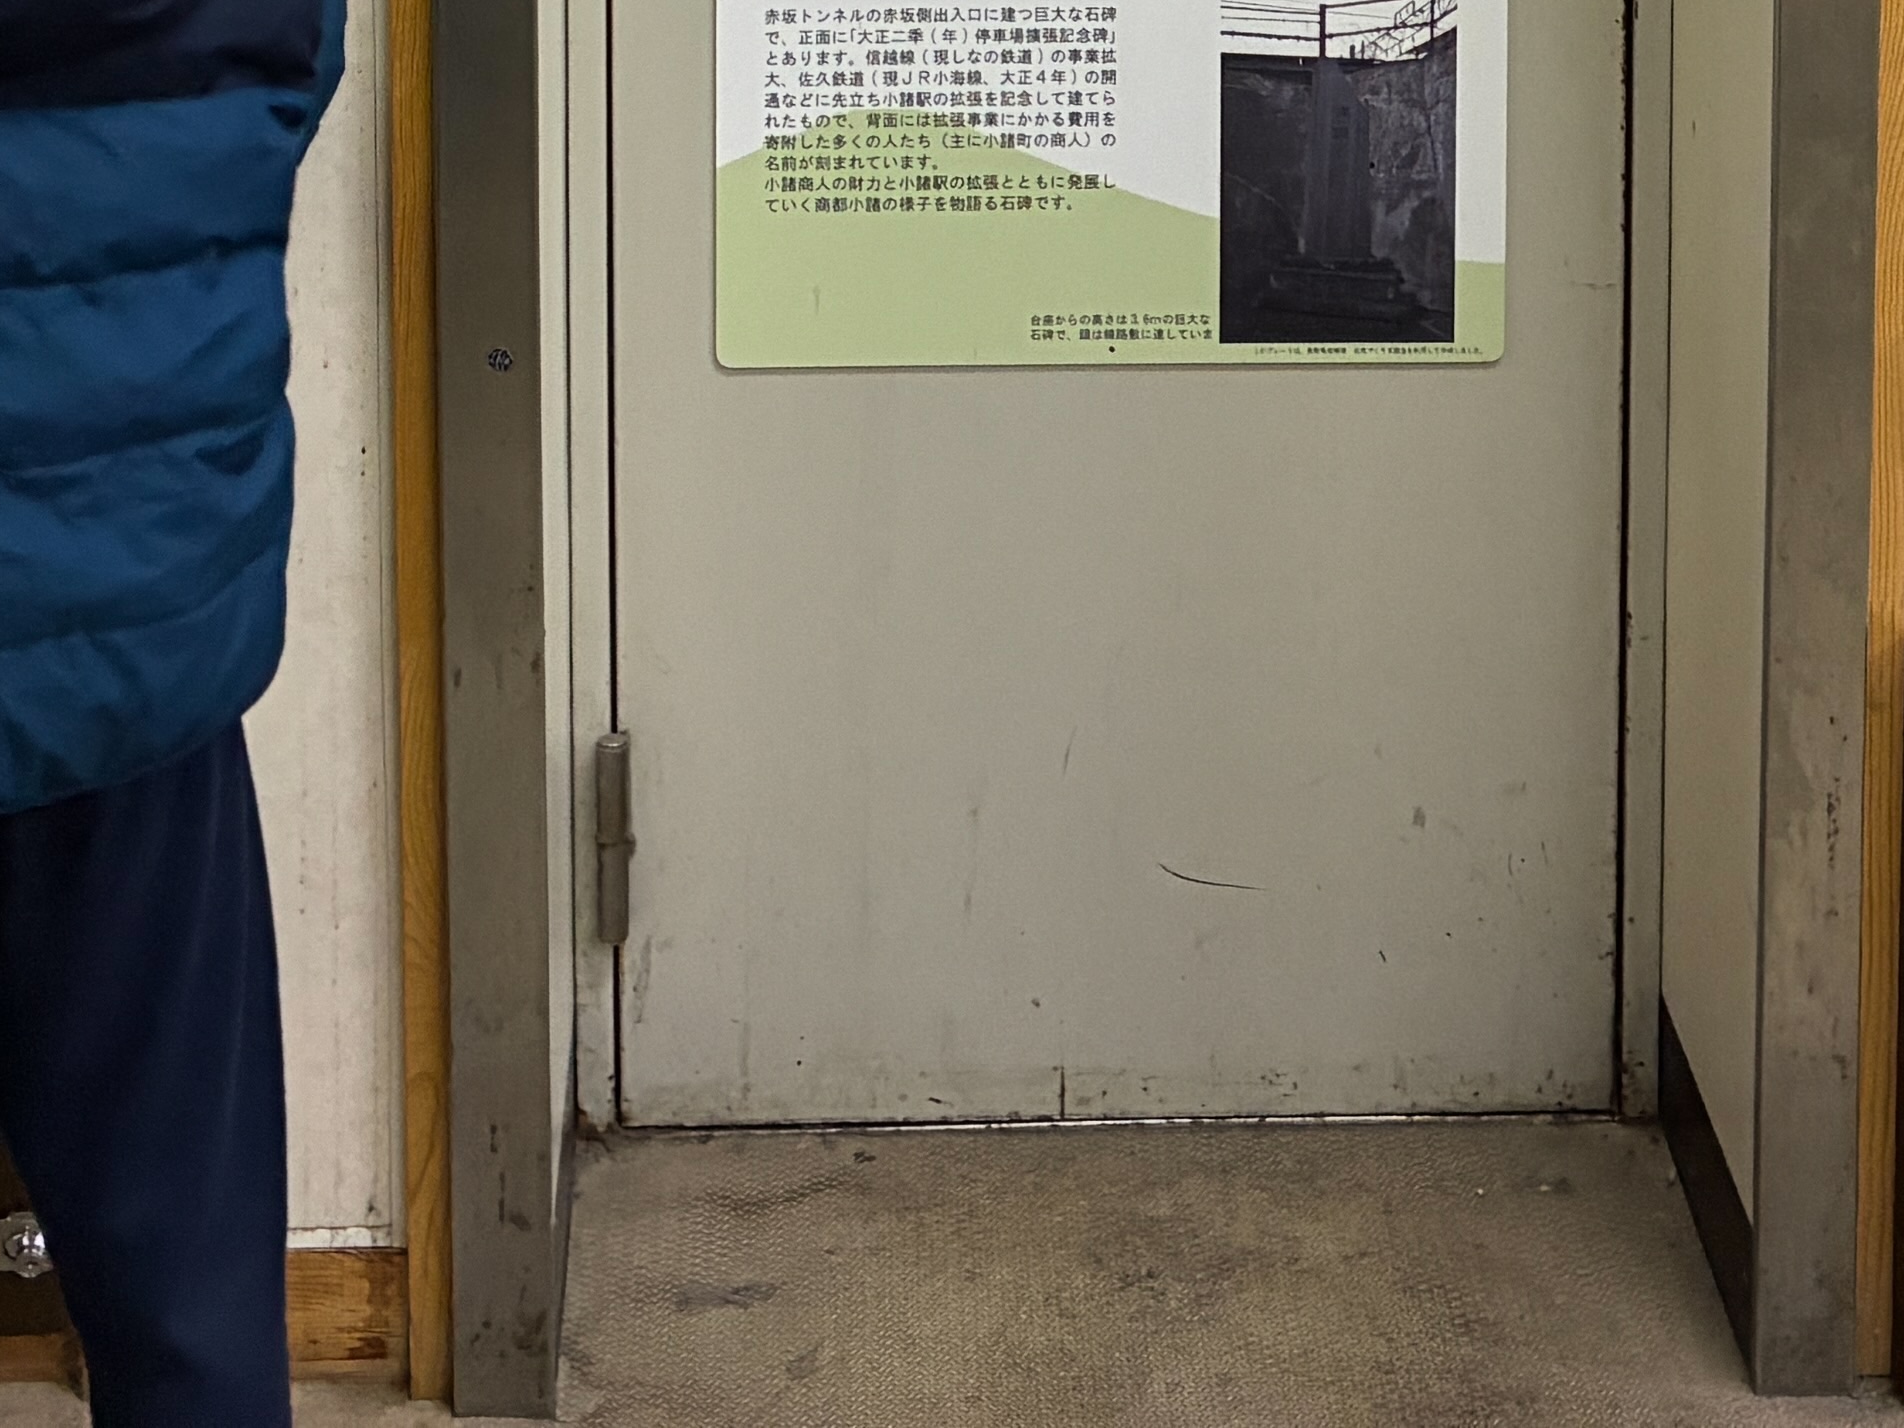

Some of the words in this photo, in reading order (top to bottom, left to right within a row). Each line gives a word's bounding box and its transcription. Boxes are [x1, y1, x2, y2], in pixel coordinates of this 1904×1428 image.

[765, 8, 1117, 24] 赤坂トンネルの赤坂側出入口に建つ巨大な石碑
[765, 92, 1115, 108] 通などに先立ち小諸駅の拡張を記念して建てら
[765, 112, 1115, 128] れたもので、背面には拡張事業にかかる費用を
[765, 155, 939, 171] 名前が刻まれています。
[765, 175, 1115, 191] 小諸商人の財力と小諸駅の拡張とともに発展し
[766, 196, 1073, 213] ていく商都小諸の様子を物語る石碑です。
